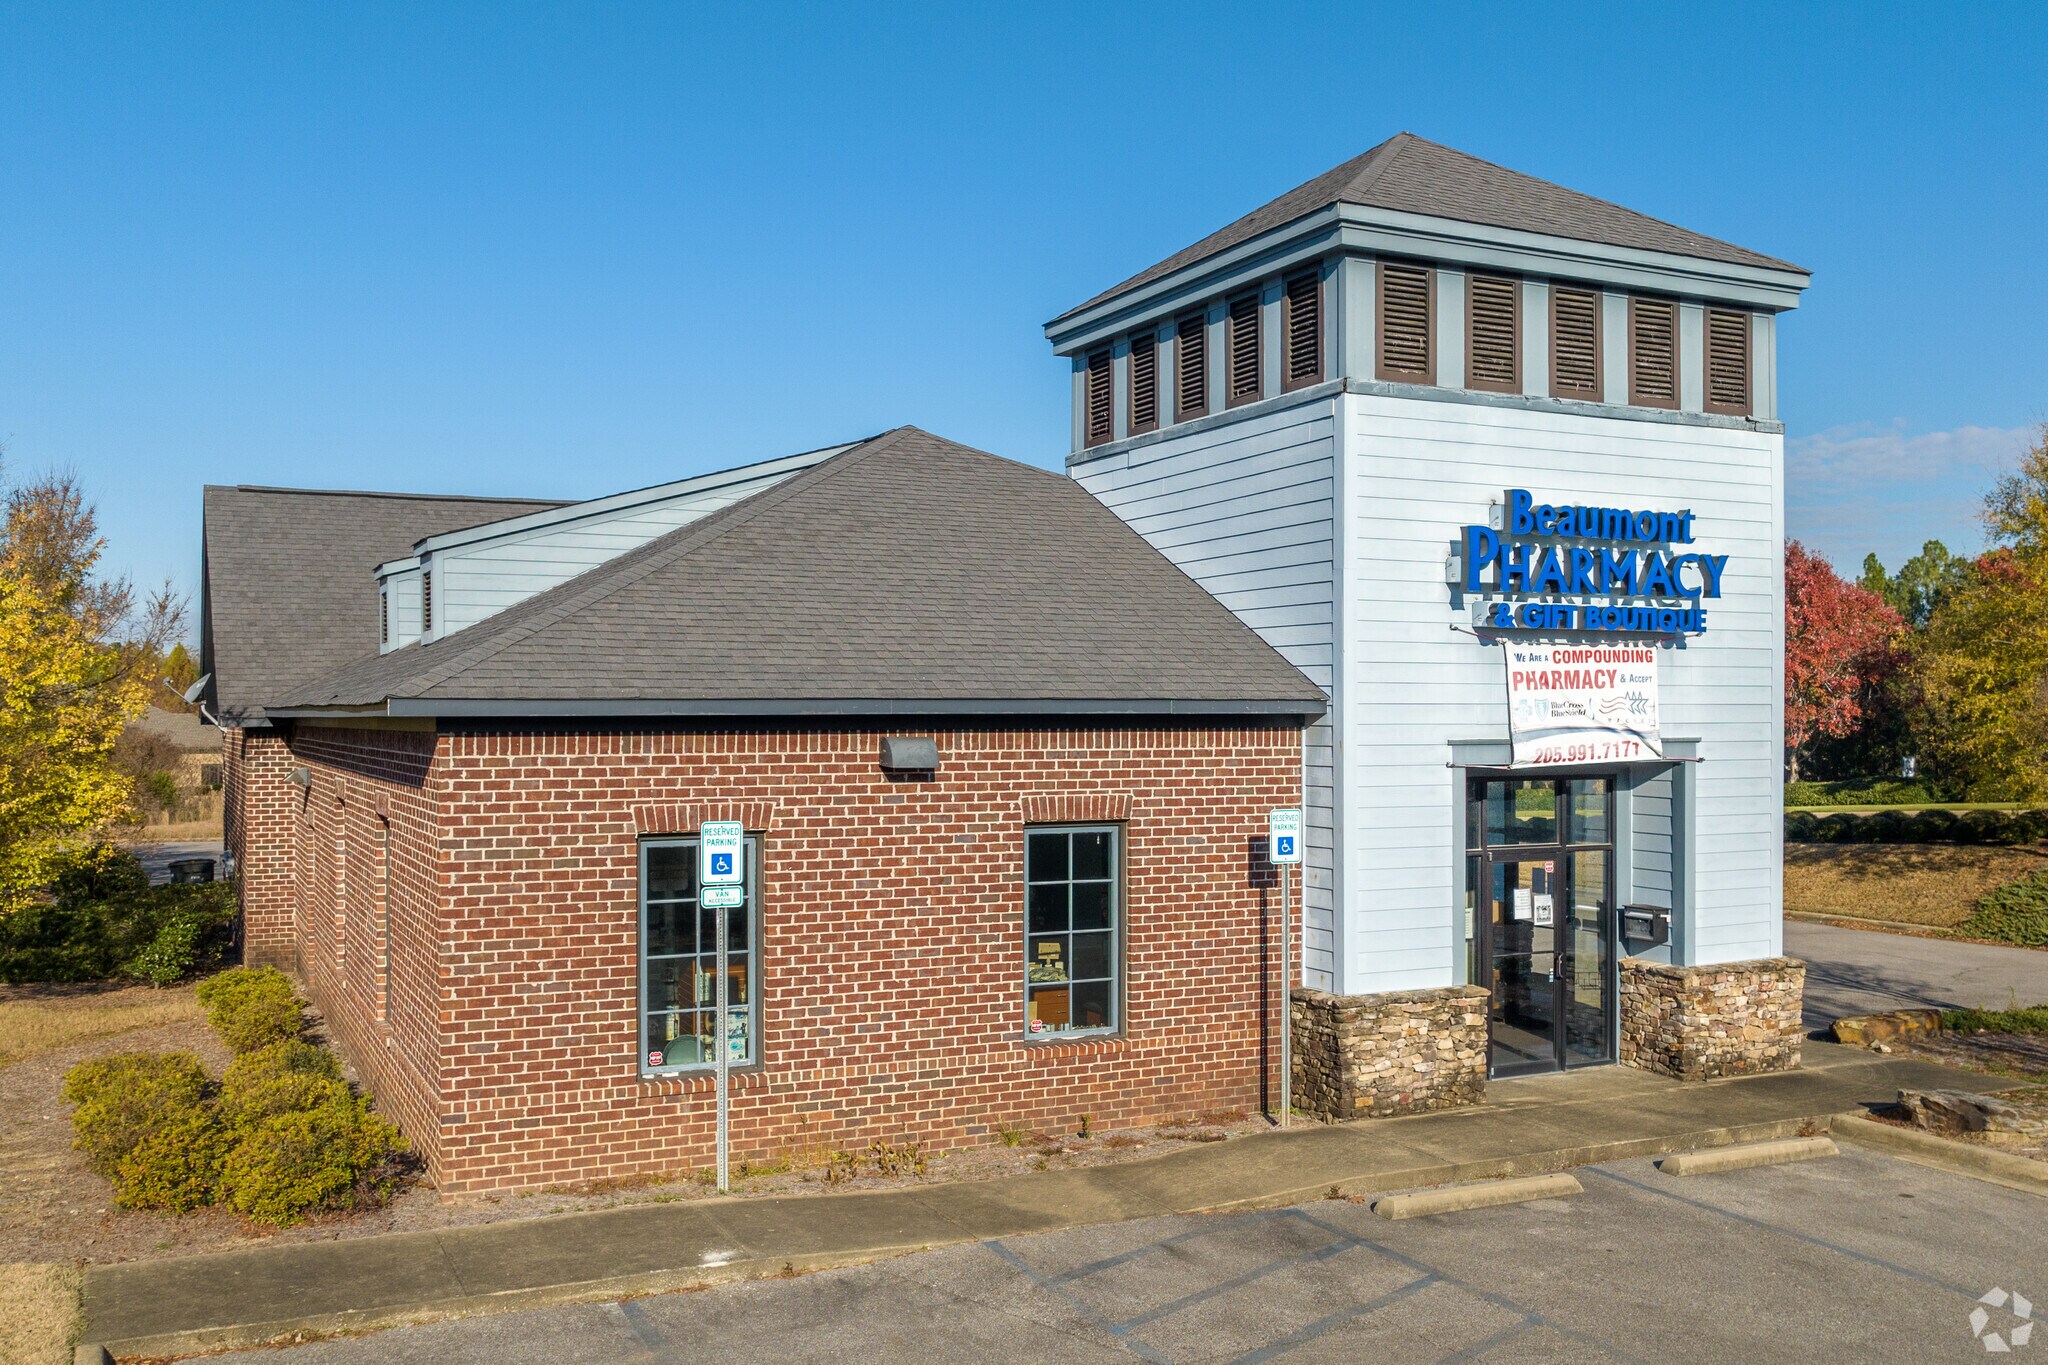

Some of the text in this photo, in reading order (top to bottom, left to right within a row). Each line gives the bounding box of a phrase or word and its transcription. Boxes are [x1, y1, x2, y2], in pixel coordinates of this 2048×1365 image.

[1505, 489, 1696, 544] Beaumont
[1462, 525, 1729, 599] PHARMACY
[1492, 603, 1707, 633] & GIFT BOUTIQUE
[1552, 650, 1653, 664] COMPOUNDING
[1512, 669, 1653, 691] PHARMACY & ACCEPT
[704, 828, 739, 836] RESERVED
[706, 838, 737, 846] PARKING
